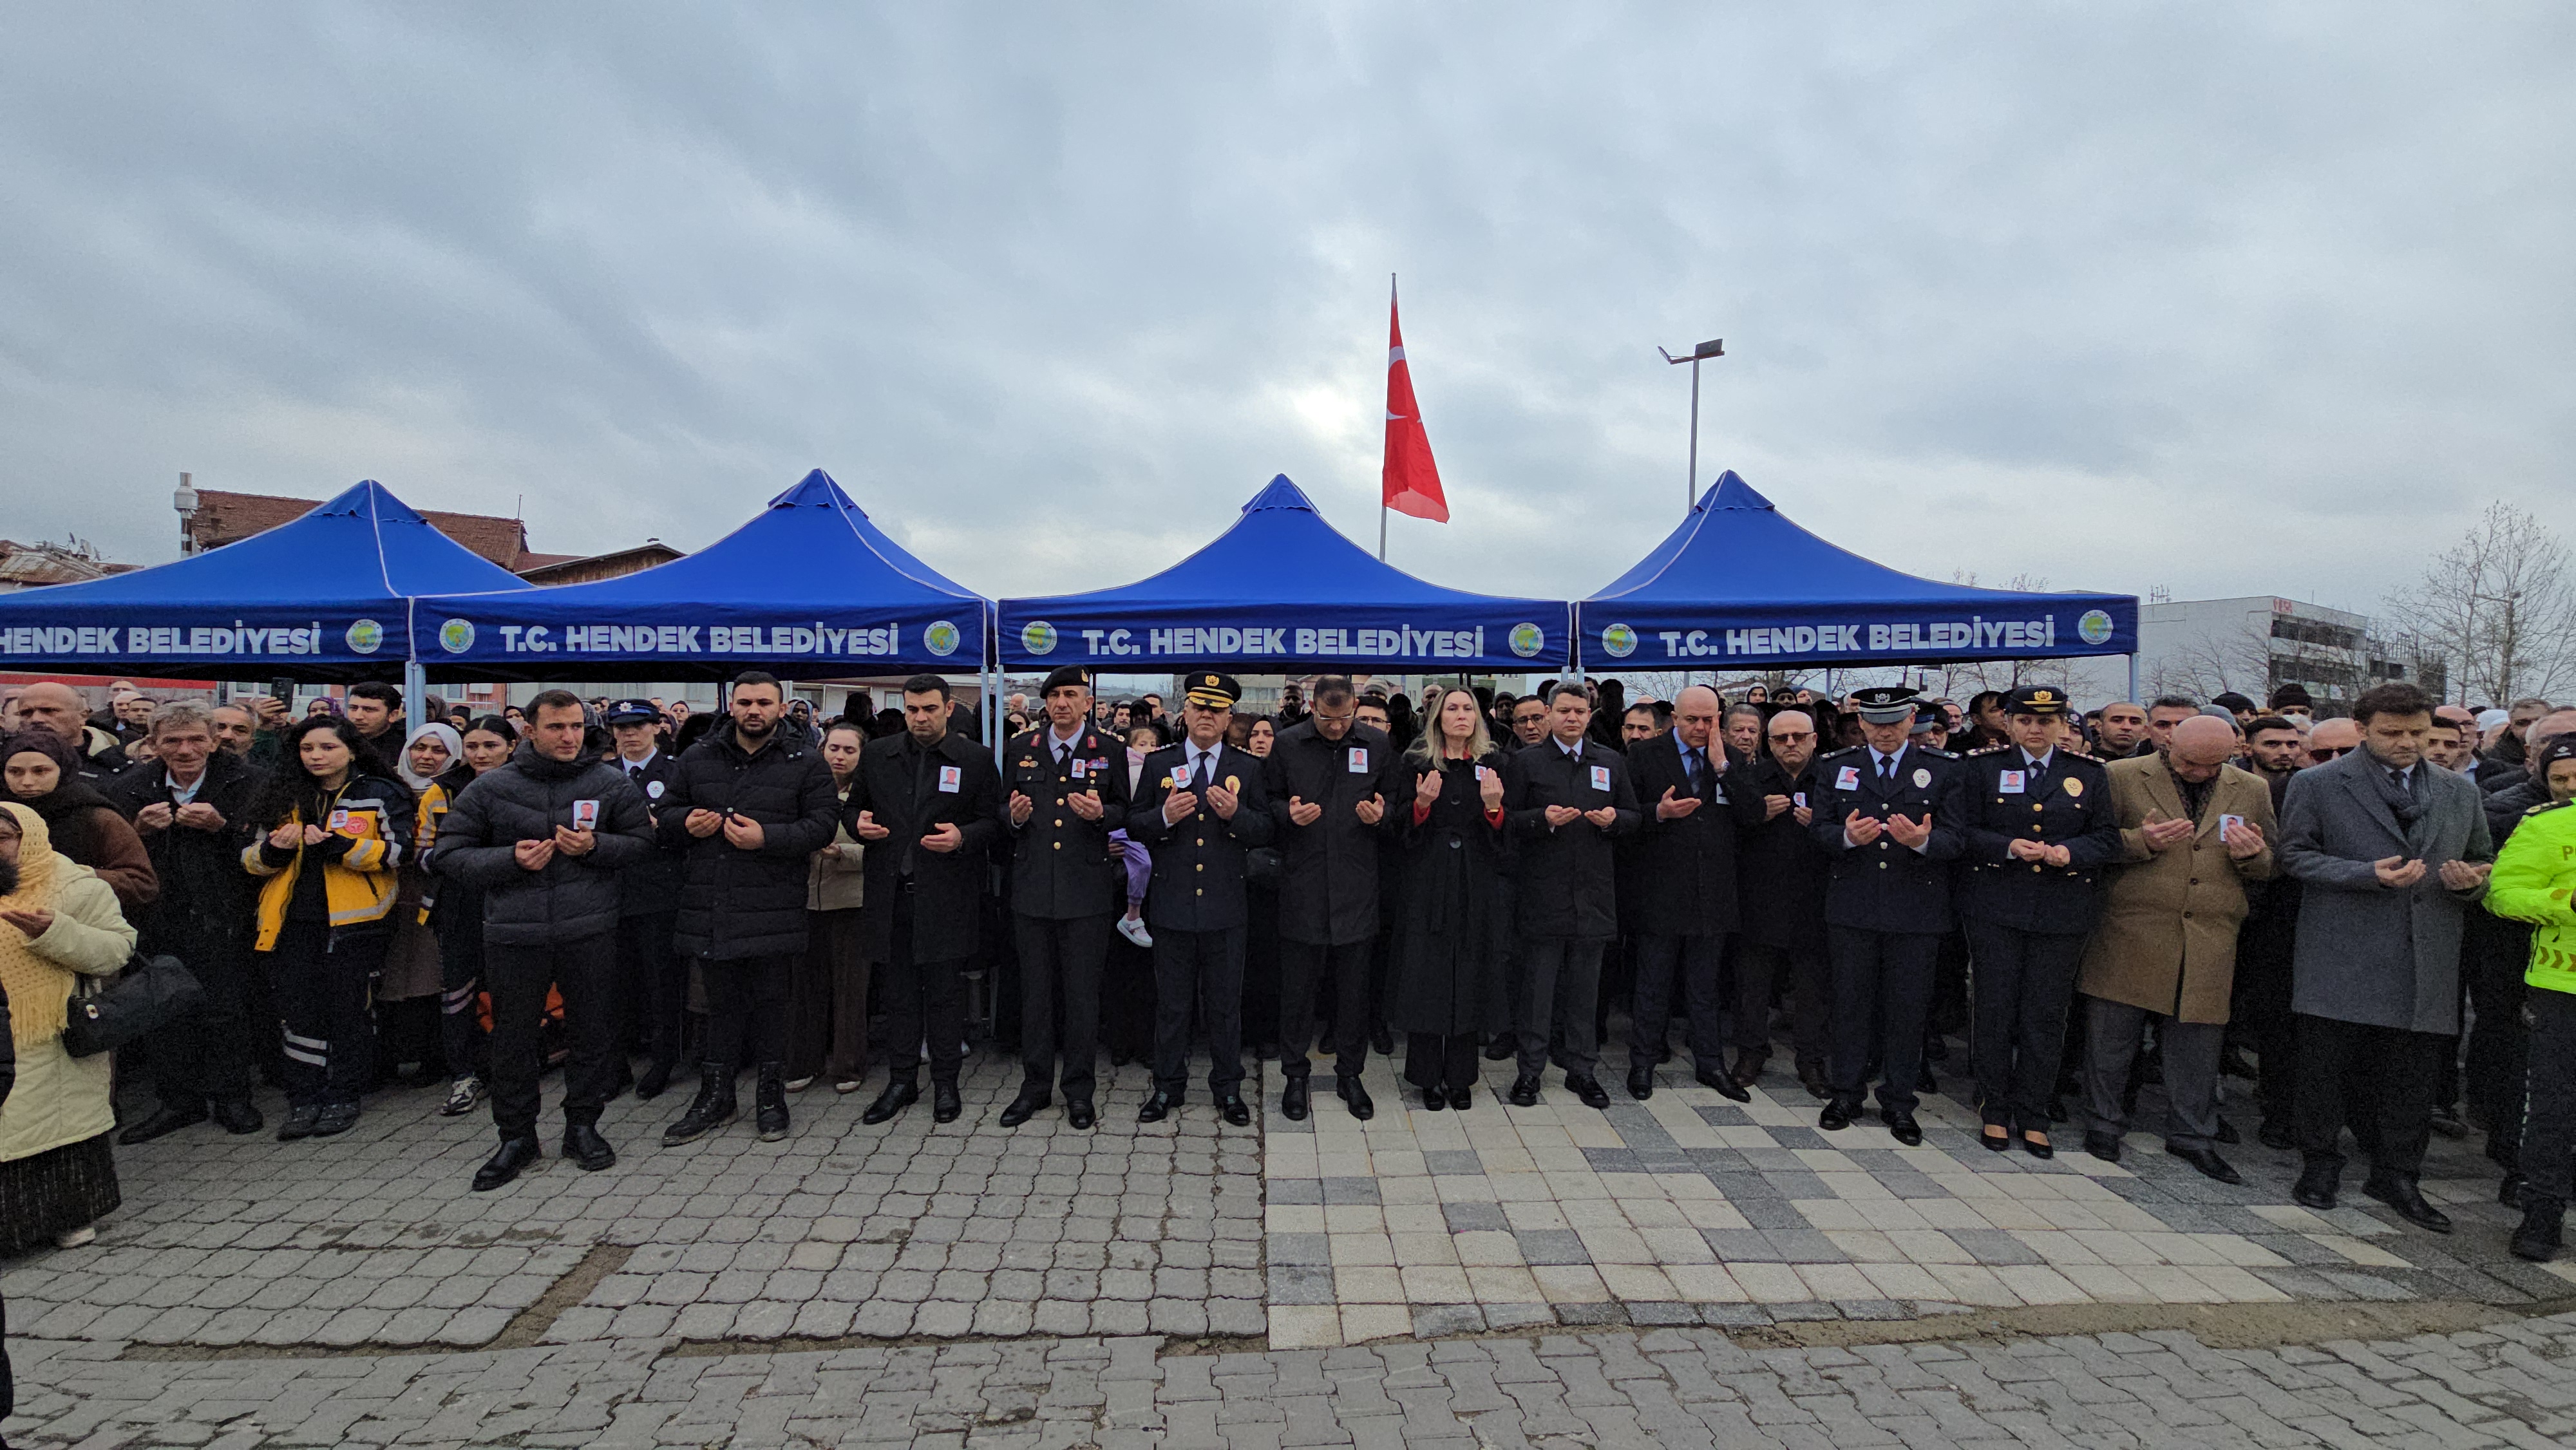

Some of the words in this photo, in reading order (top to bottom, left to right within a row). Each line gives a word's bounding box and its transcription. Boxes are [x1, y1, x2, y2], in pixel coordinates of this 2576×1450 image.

[128, 619, 321, 654] BELEDİYESİ
[499, 625, 558, 652] T.C.
[565, 625, 701, 652] HENDEK
[709, 621, 899, 655] BELEDİYESİ
[1081, 628, 1141, 655] T.C.
[1150, 627, 1287, 655] HENDEK
[1295, 624, 1484, 657] BELEDİYESİ
[1659, 630, 1718, 657] T.C.
[1726, 625, 1861, 655] HENDEK
[1869, 614, 2055, 650] BELEDİYESİ
